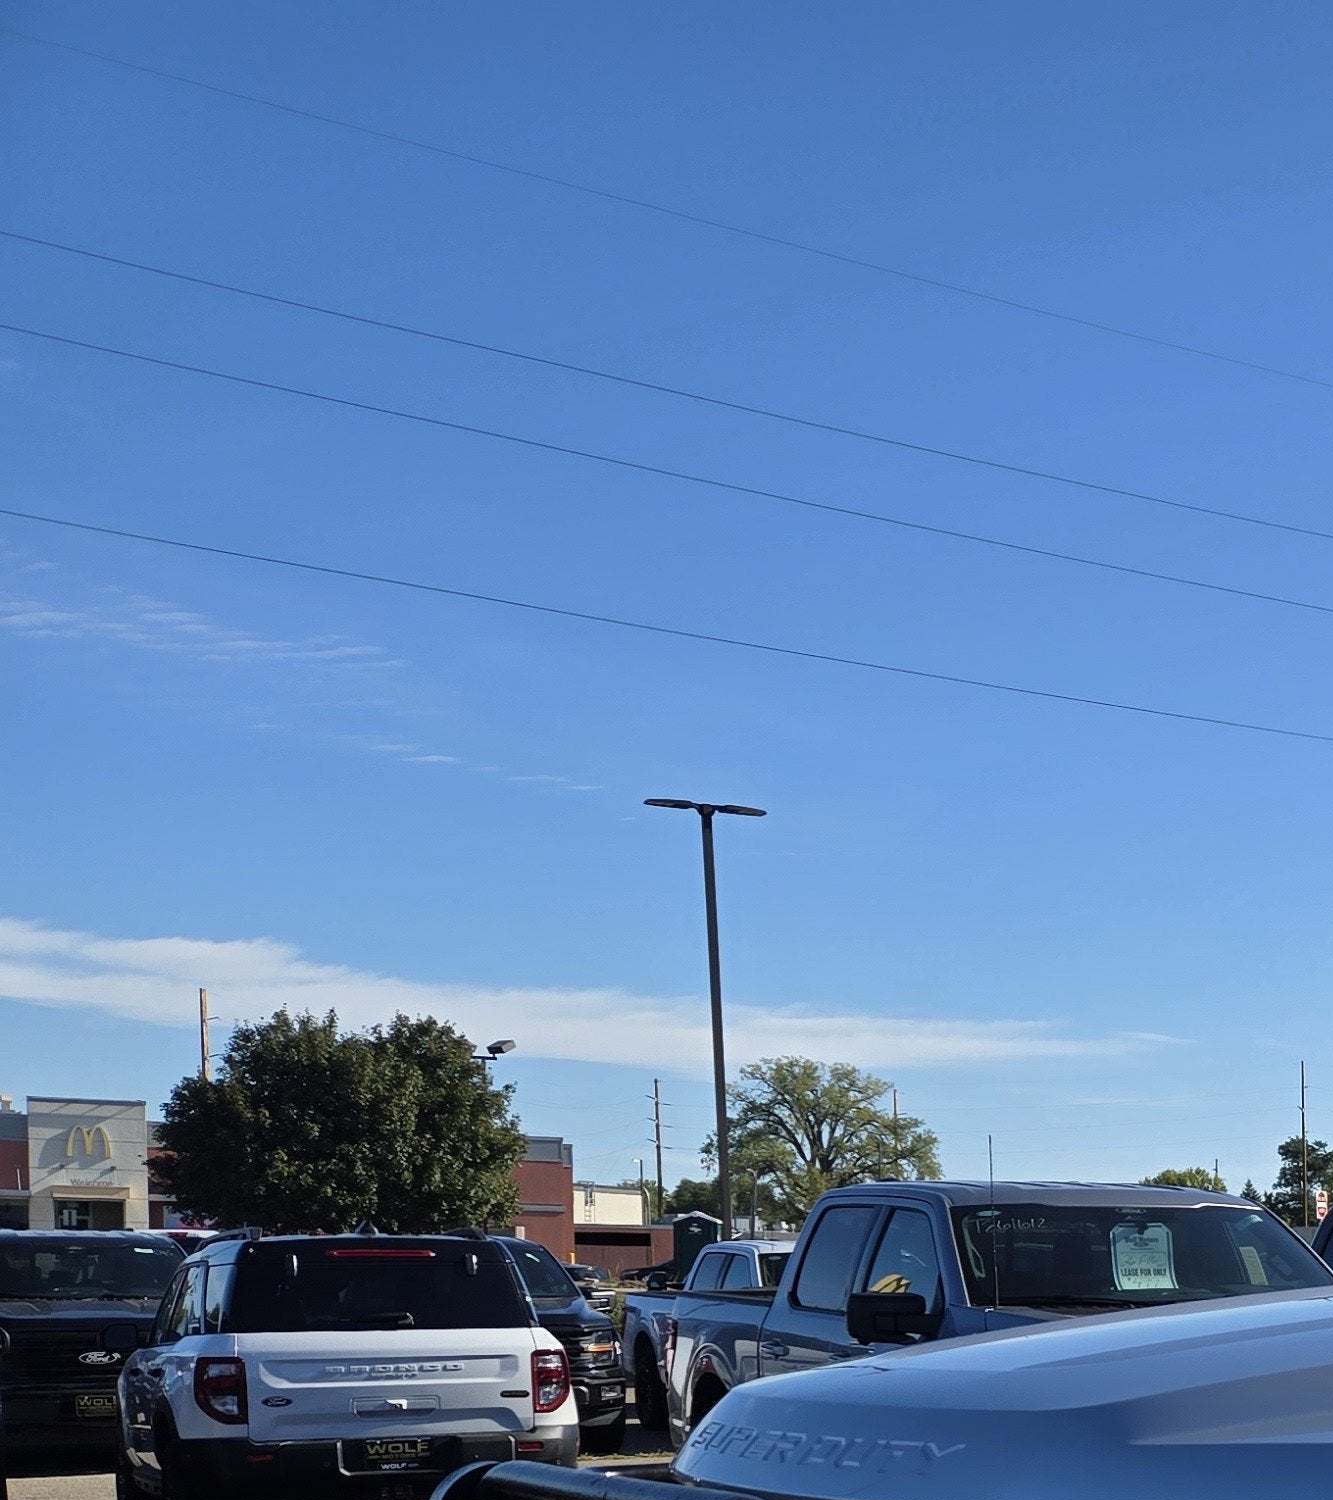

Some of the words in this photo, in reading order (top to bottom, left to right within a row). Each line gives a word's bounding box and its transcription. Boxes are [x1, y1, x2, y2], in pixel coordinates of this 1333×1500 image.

[1120, 1267, 1139, 1276] LEASE
[1140, 1267, 1152, 1276] FOR
[1153, 1267, 1167, 1276] ONLY
[366, 1442, 429, 1454] WOLF
[381, 1462, 407, 1470] WOLF
